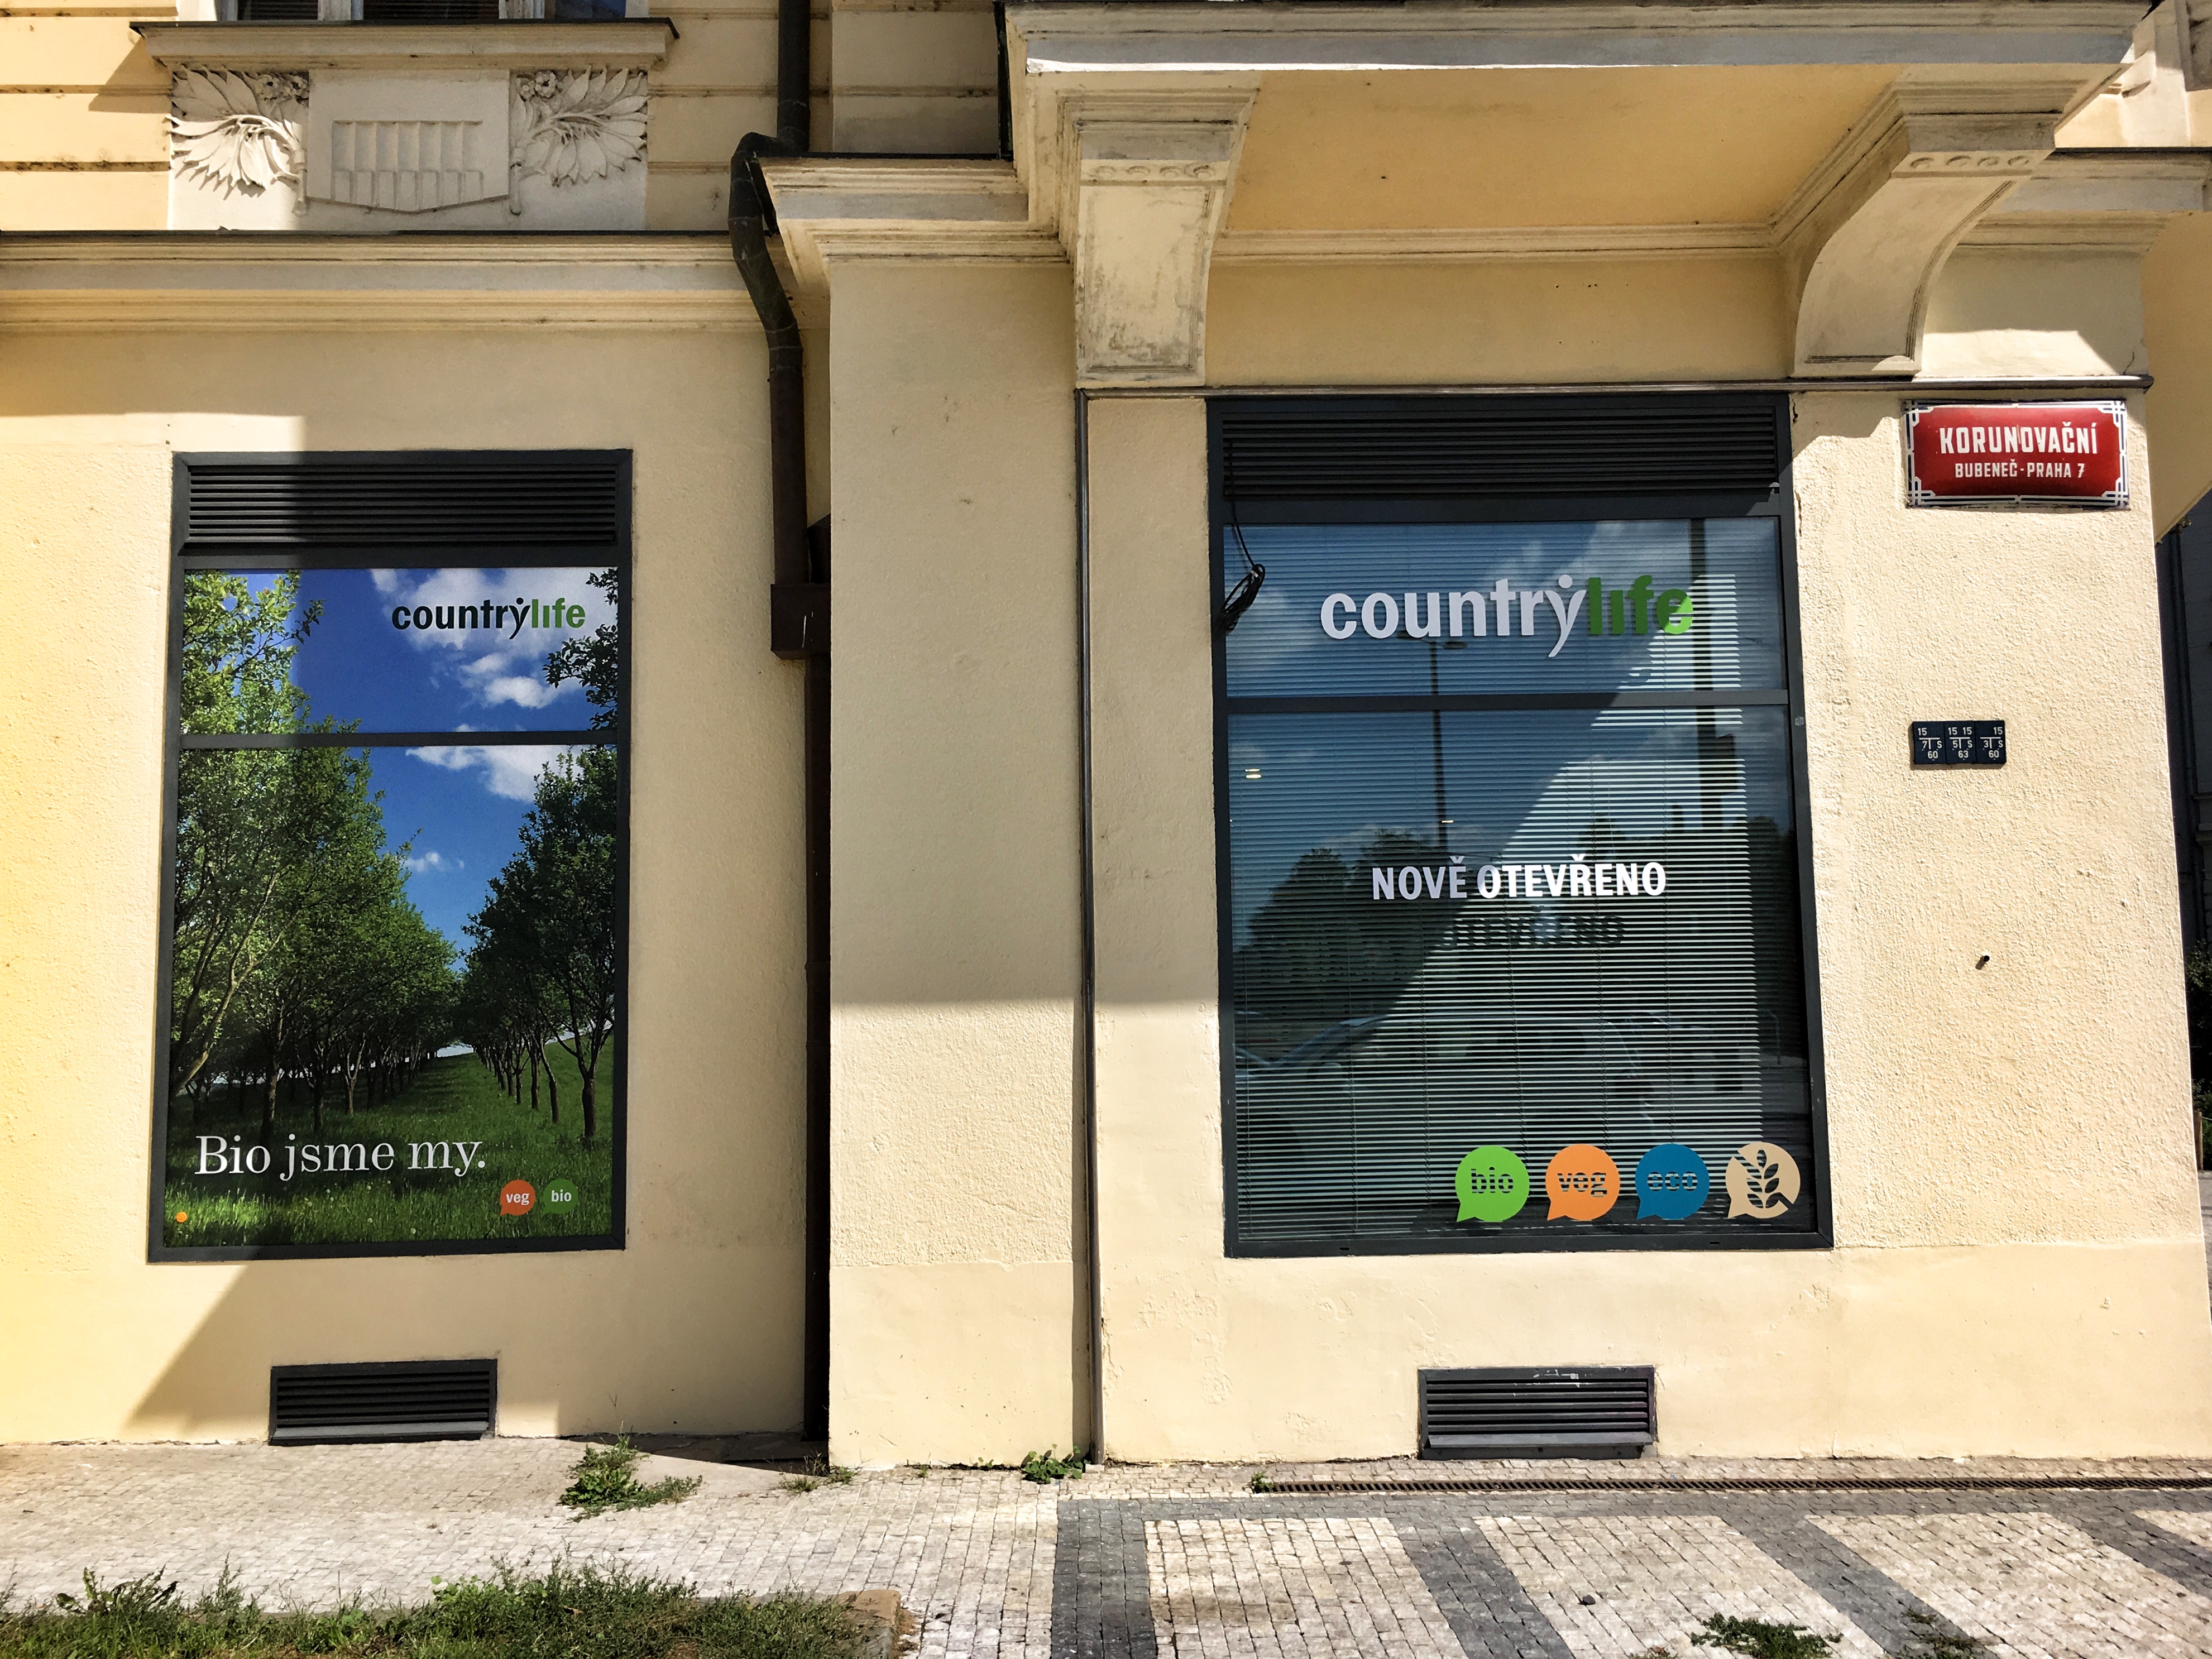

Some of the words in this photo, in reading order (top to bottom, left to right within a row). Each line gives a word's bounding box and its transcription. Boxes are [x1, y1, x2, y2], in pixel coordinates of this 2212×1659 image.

[1940, 421, 2097, 454] KORUNOVAČNÍ
[2077, 463, 2084, 478] 7
[1372, 856, 1467, 900] NOVĚ
[1477, 854, 1666, 899] OTEVŘENO
[195, 1135, 270, 1175] Bio
[279, 1134, 394, 1182] jsme
[408, 1141, 486, 1177] my.
[1471, 1167, 1514, 1194] bio
[1557, 1171, 1606, 1197] veg
[1646, 1171, 1698, 1192] eco
[506, 1190, 529, 1206] veg
[551, 1189, 572, 1203] bio
